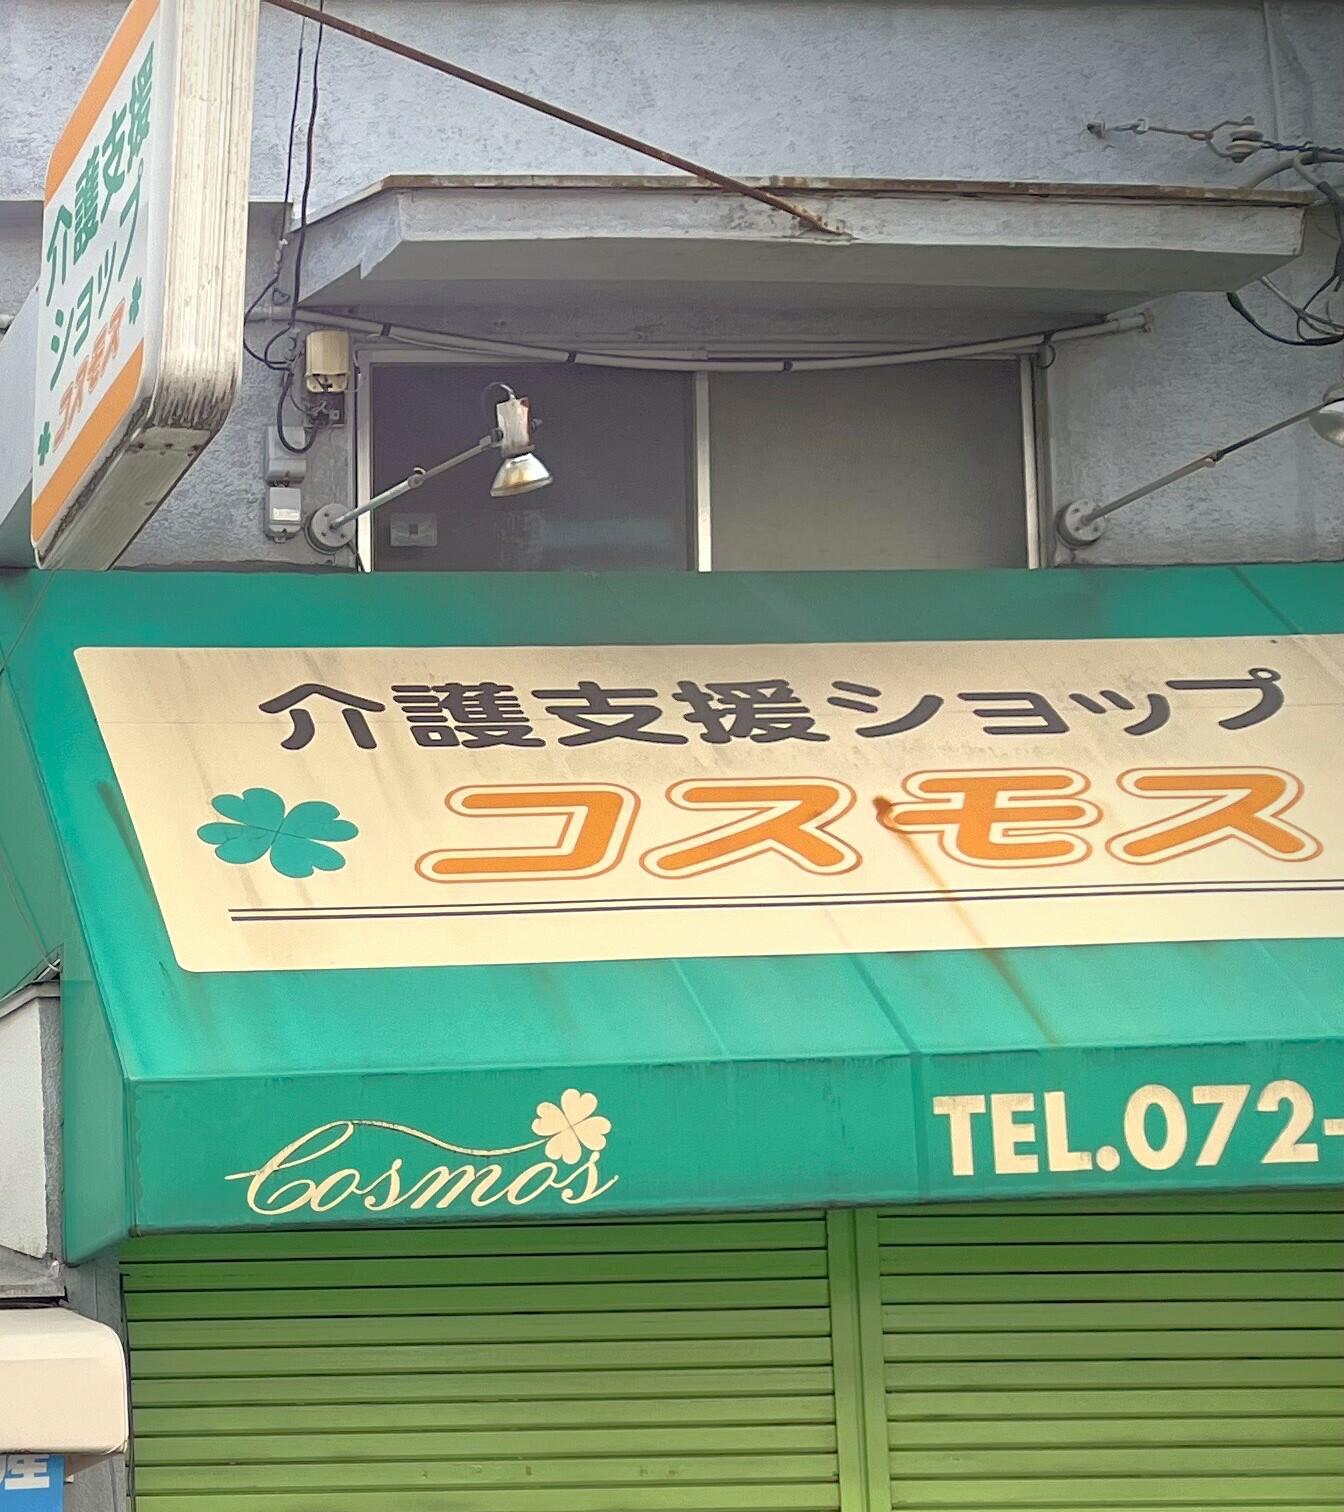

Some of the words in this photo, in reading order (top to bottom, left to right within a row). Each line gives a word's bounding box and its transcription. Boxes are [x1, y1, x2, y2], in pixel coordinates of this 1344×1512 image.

[47, 41, 154, 306] 介護支援
[50, 159, 145, 391] ショップ
[259, 667, 1284, 752] 介護支援ショップ
[415, 765, 1322, 884] コスモス
[225, 1118, 618, 1216] Cosmos
